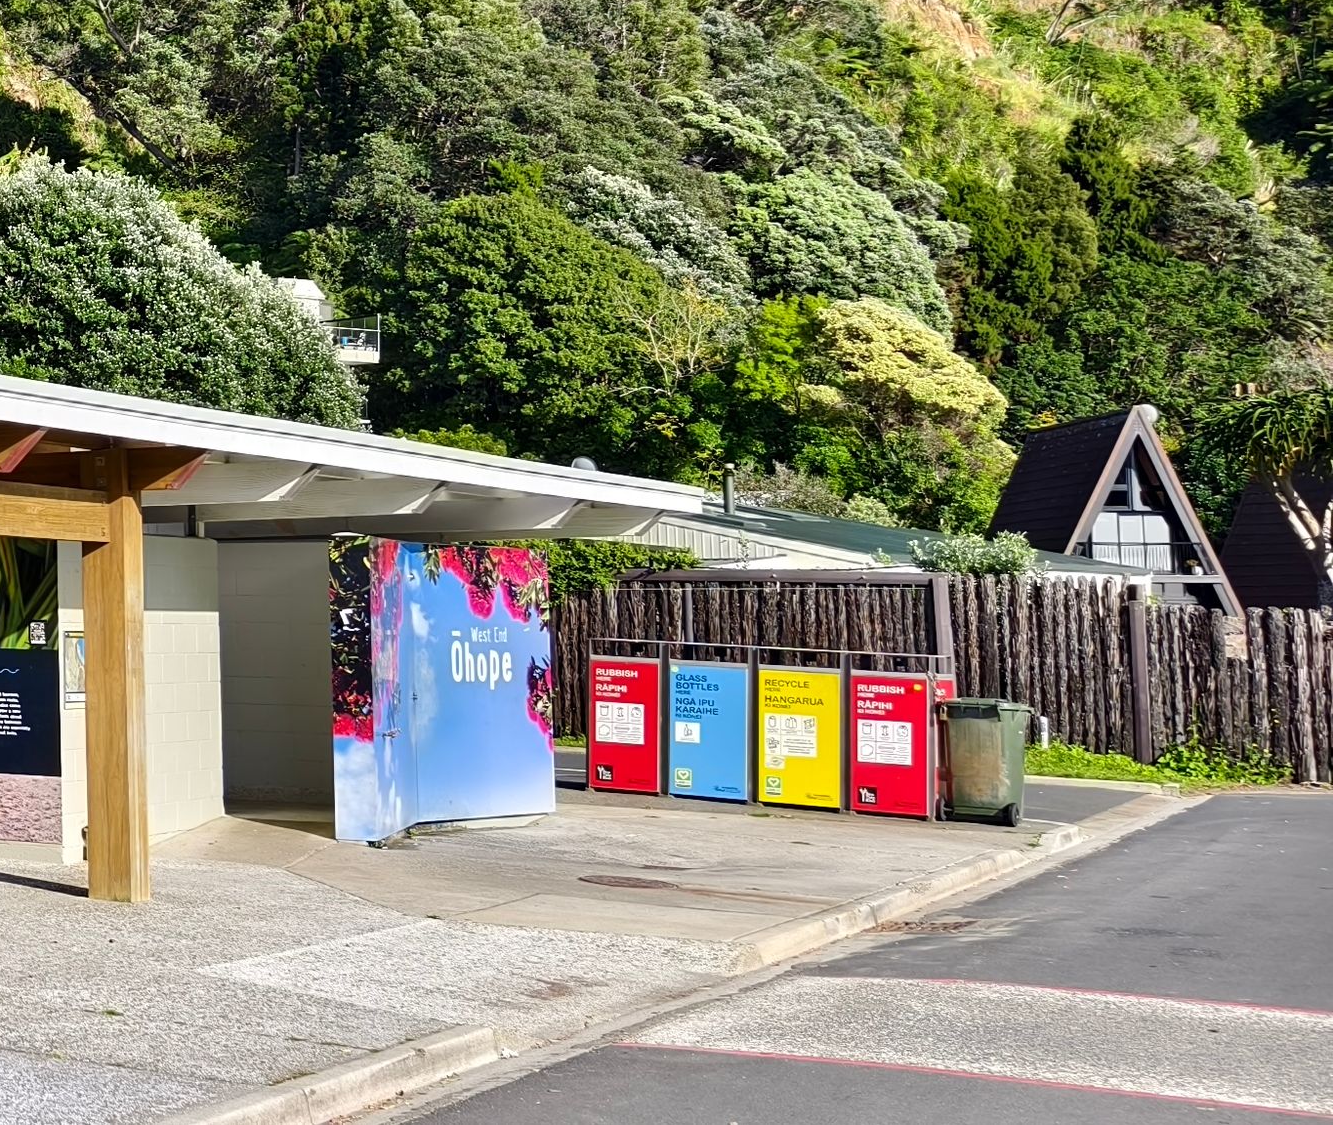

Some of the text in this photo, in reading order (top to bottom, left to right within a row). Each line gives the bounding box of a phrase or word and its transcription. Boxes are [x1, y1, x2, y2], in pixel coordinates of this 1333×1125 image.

[470, 626, 508, 643] West End
[451, 630, 513, 691] Ōhope
[596, 668, 638, 678] RUBBISH
[675, 673, 708, 682] GLASS
[675, 681, 719, 692] BOTTLES
[764, 679, 810, 689] RECYCLE
[857, 684, 905, 695] RUBBISH
[698, 698, 715, 707] IPU
[764, 695, 824, 706] HANGARUA
[675, 705, 719, 716] KARAIHE
